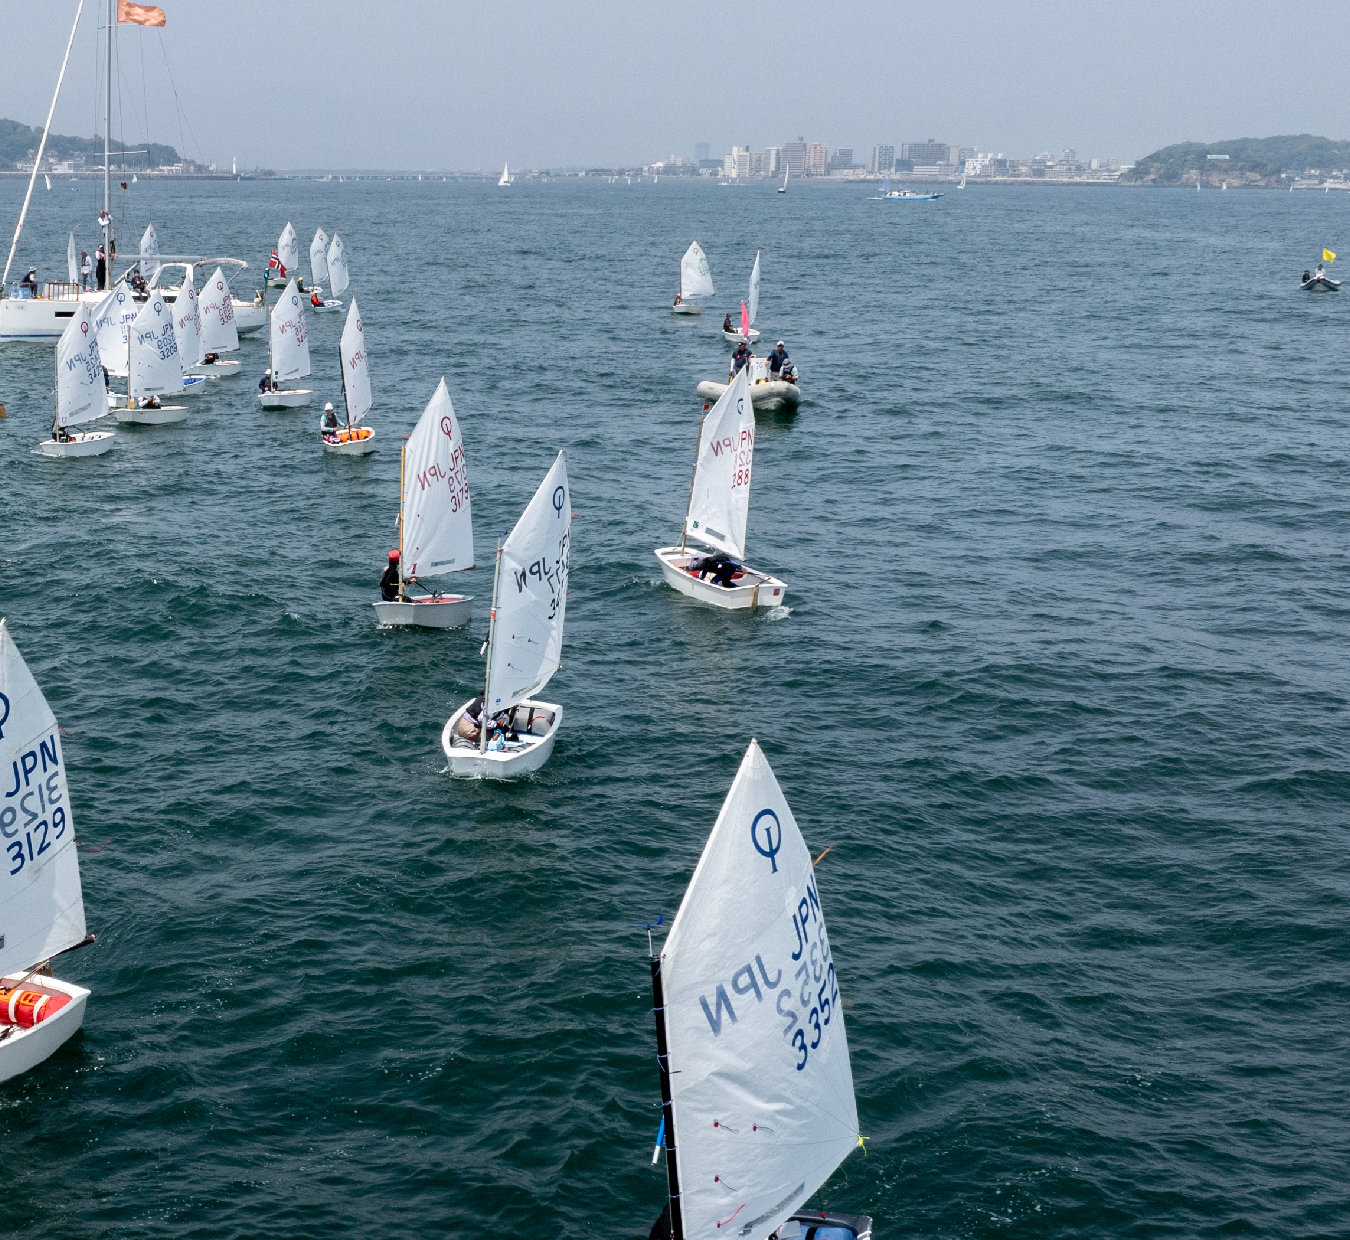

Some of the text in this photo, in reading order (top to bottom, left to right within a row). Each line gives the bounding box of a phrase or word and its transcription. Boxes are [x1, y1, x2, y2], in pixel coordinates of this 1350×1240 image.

[120, 312, 138, 324] JPN
[161, 321, 174, 337] JPN
[738, 428, 754, 448] JPN
[449, 444, 464, 472] JPN
[450, 482, 468, 513] 3179
[4, 734, 60, 798] JPN
[6, 806, 67, 876] 3129
[791, 872, 822, 962] JPN
[792, 962, 838, 1072] 3352
